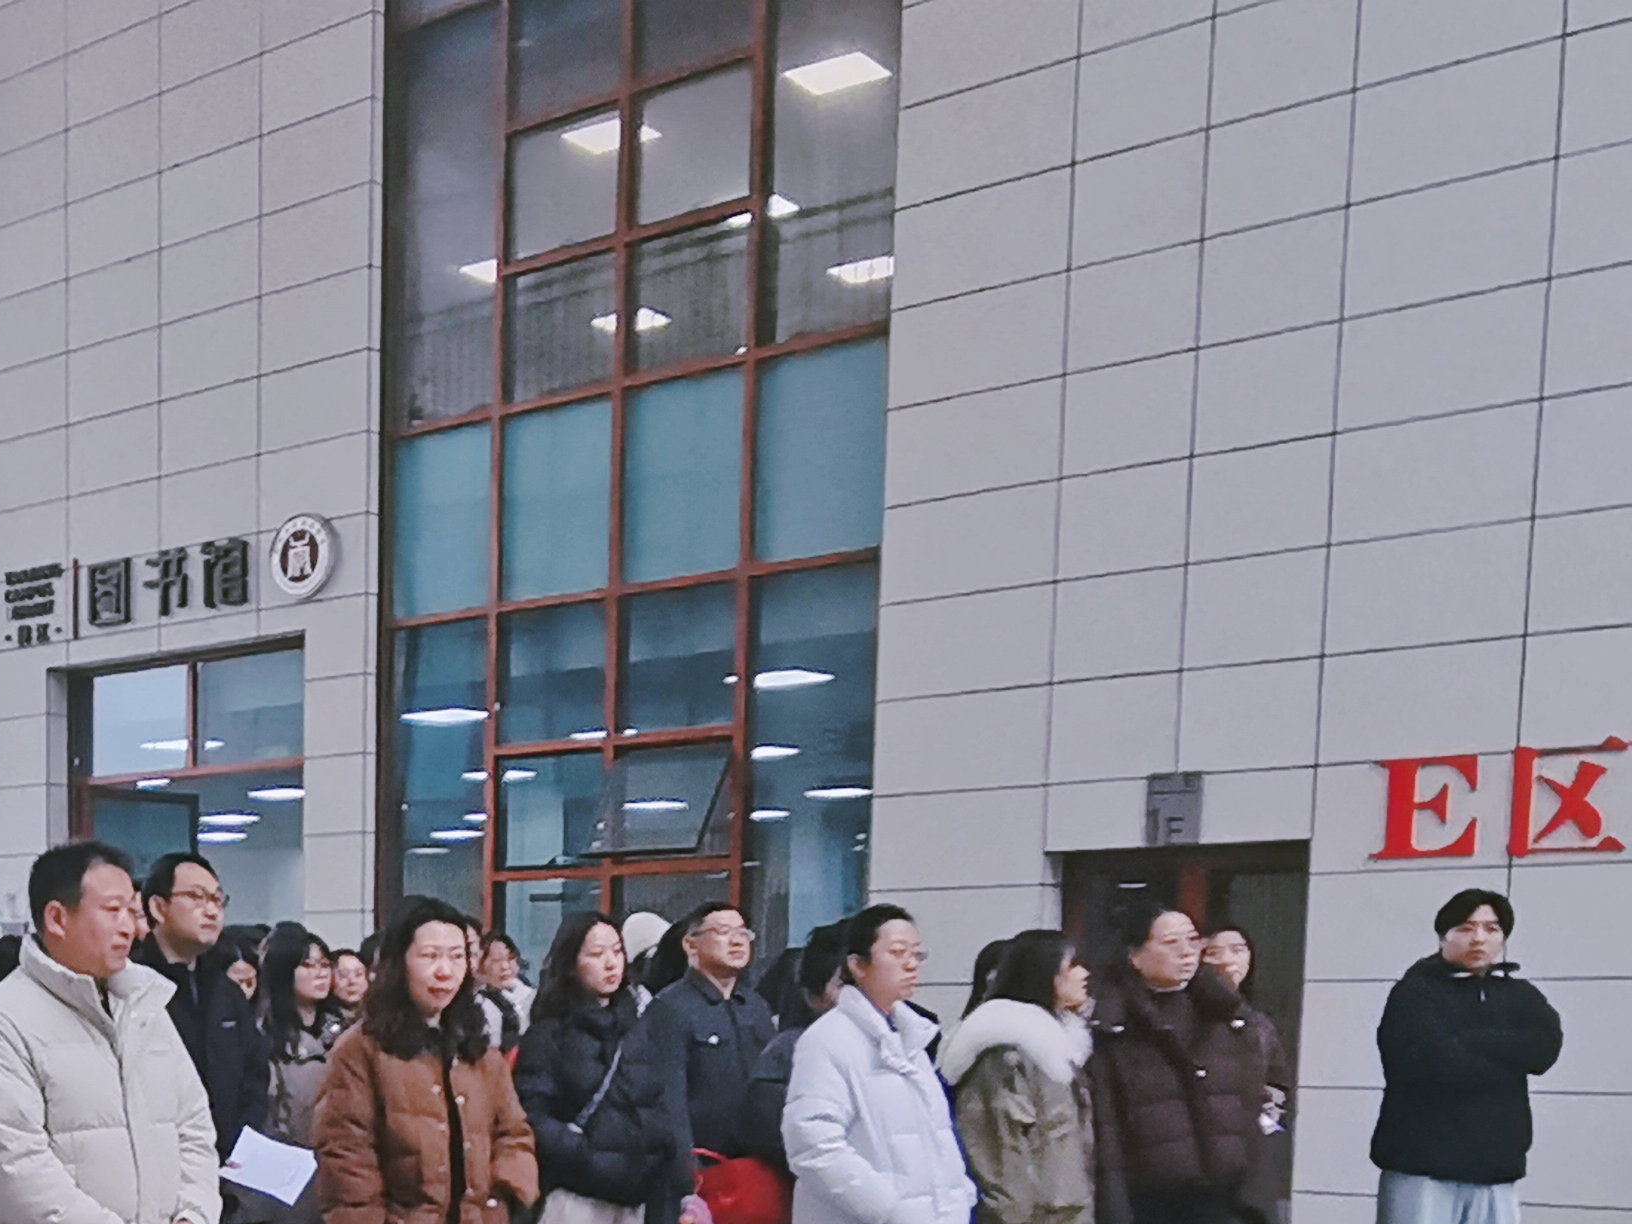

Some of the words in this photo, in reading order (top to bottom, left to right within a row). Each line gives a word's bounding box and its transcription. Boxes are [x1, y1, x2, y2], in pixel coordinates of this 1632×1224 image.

[87, 537, 249, 626] 图书馆
[1368, 735, 1631, 861] E区
